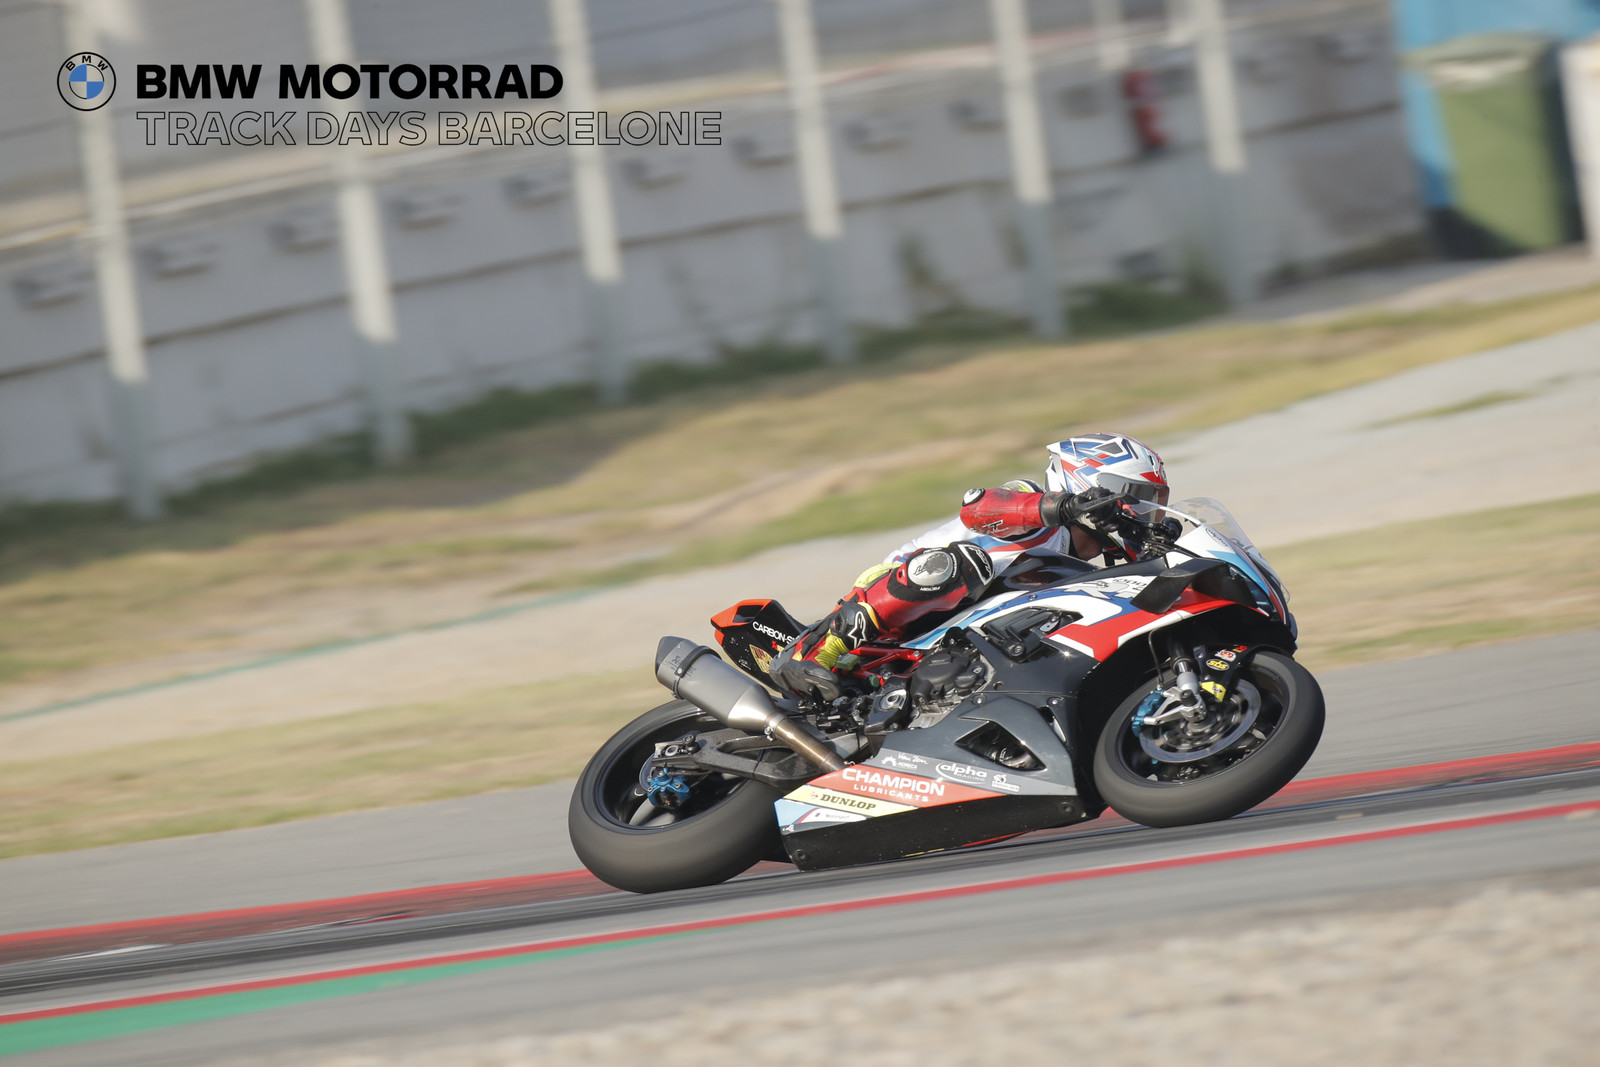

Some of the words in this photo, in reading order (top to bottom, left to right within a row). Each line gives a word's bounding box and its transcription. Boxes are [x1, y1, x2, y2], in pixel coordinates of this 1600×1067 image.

[752, 621, 801, 645] CARBON-S
[940, 763, 988, 779] alpha
[842, 768, 945, 796] CHAMPION
[820, 793, 877, 810] DUNLOP
[853, 784, 929, 802] LUBRICANTS
